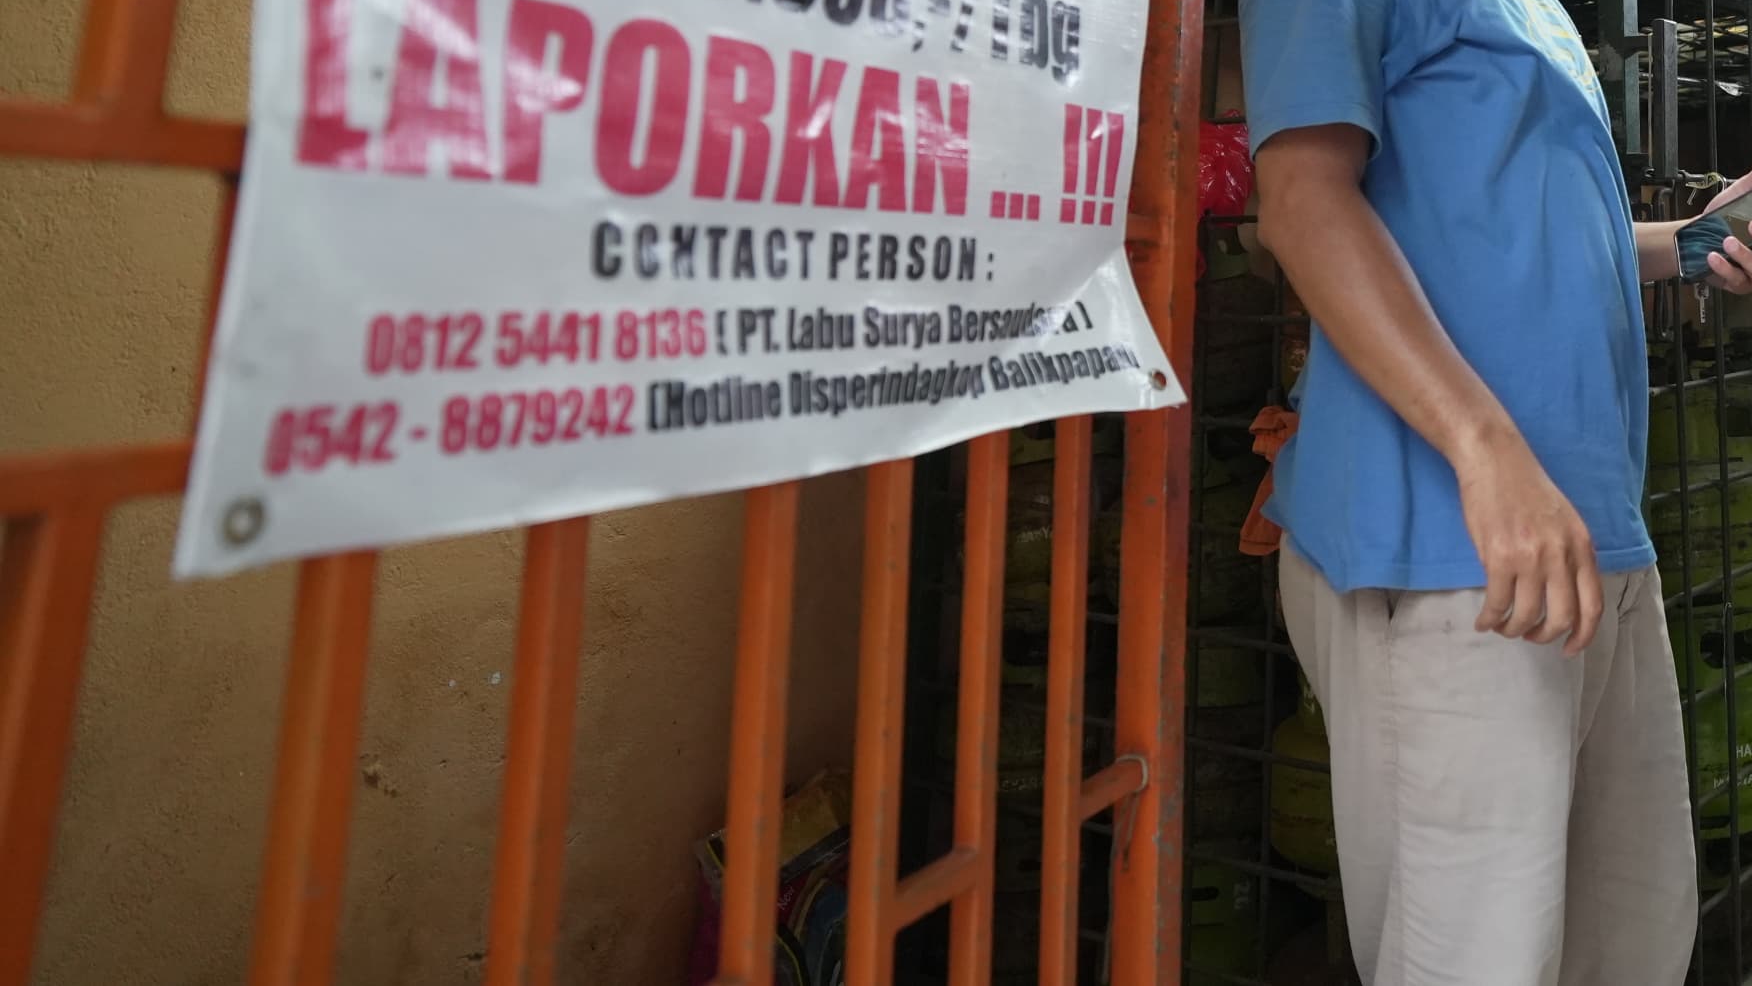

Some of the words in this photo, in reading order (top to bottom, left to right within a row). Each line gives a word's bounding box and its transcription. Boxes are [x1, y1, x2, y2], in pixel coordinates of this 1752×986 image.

[591, 221, 815, 279] CONTACT
[829, 231, 978, 281] PERSON
[365, 313, 483, 377] 0812
[495, 310, 602, 368] 5441
[614, 309, 707, 361] 8136
[737, 308, 780, 353] PT.
[788, 306, 854, 351] Labu
[864, 305, 942, 349] Surya
[264, 401, 401, 476] 0542
[438, 384, 636, 455] 8879242
